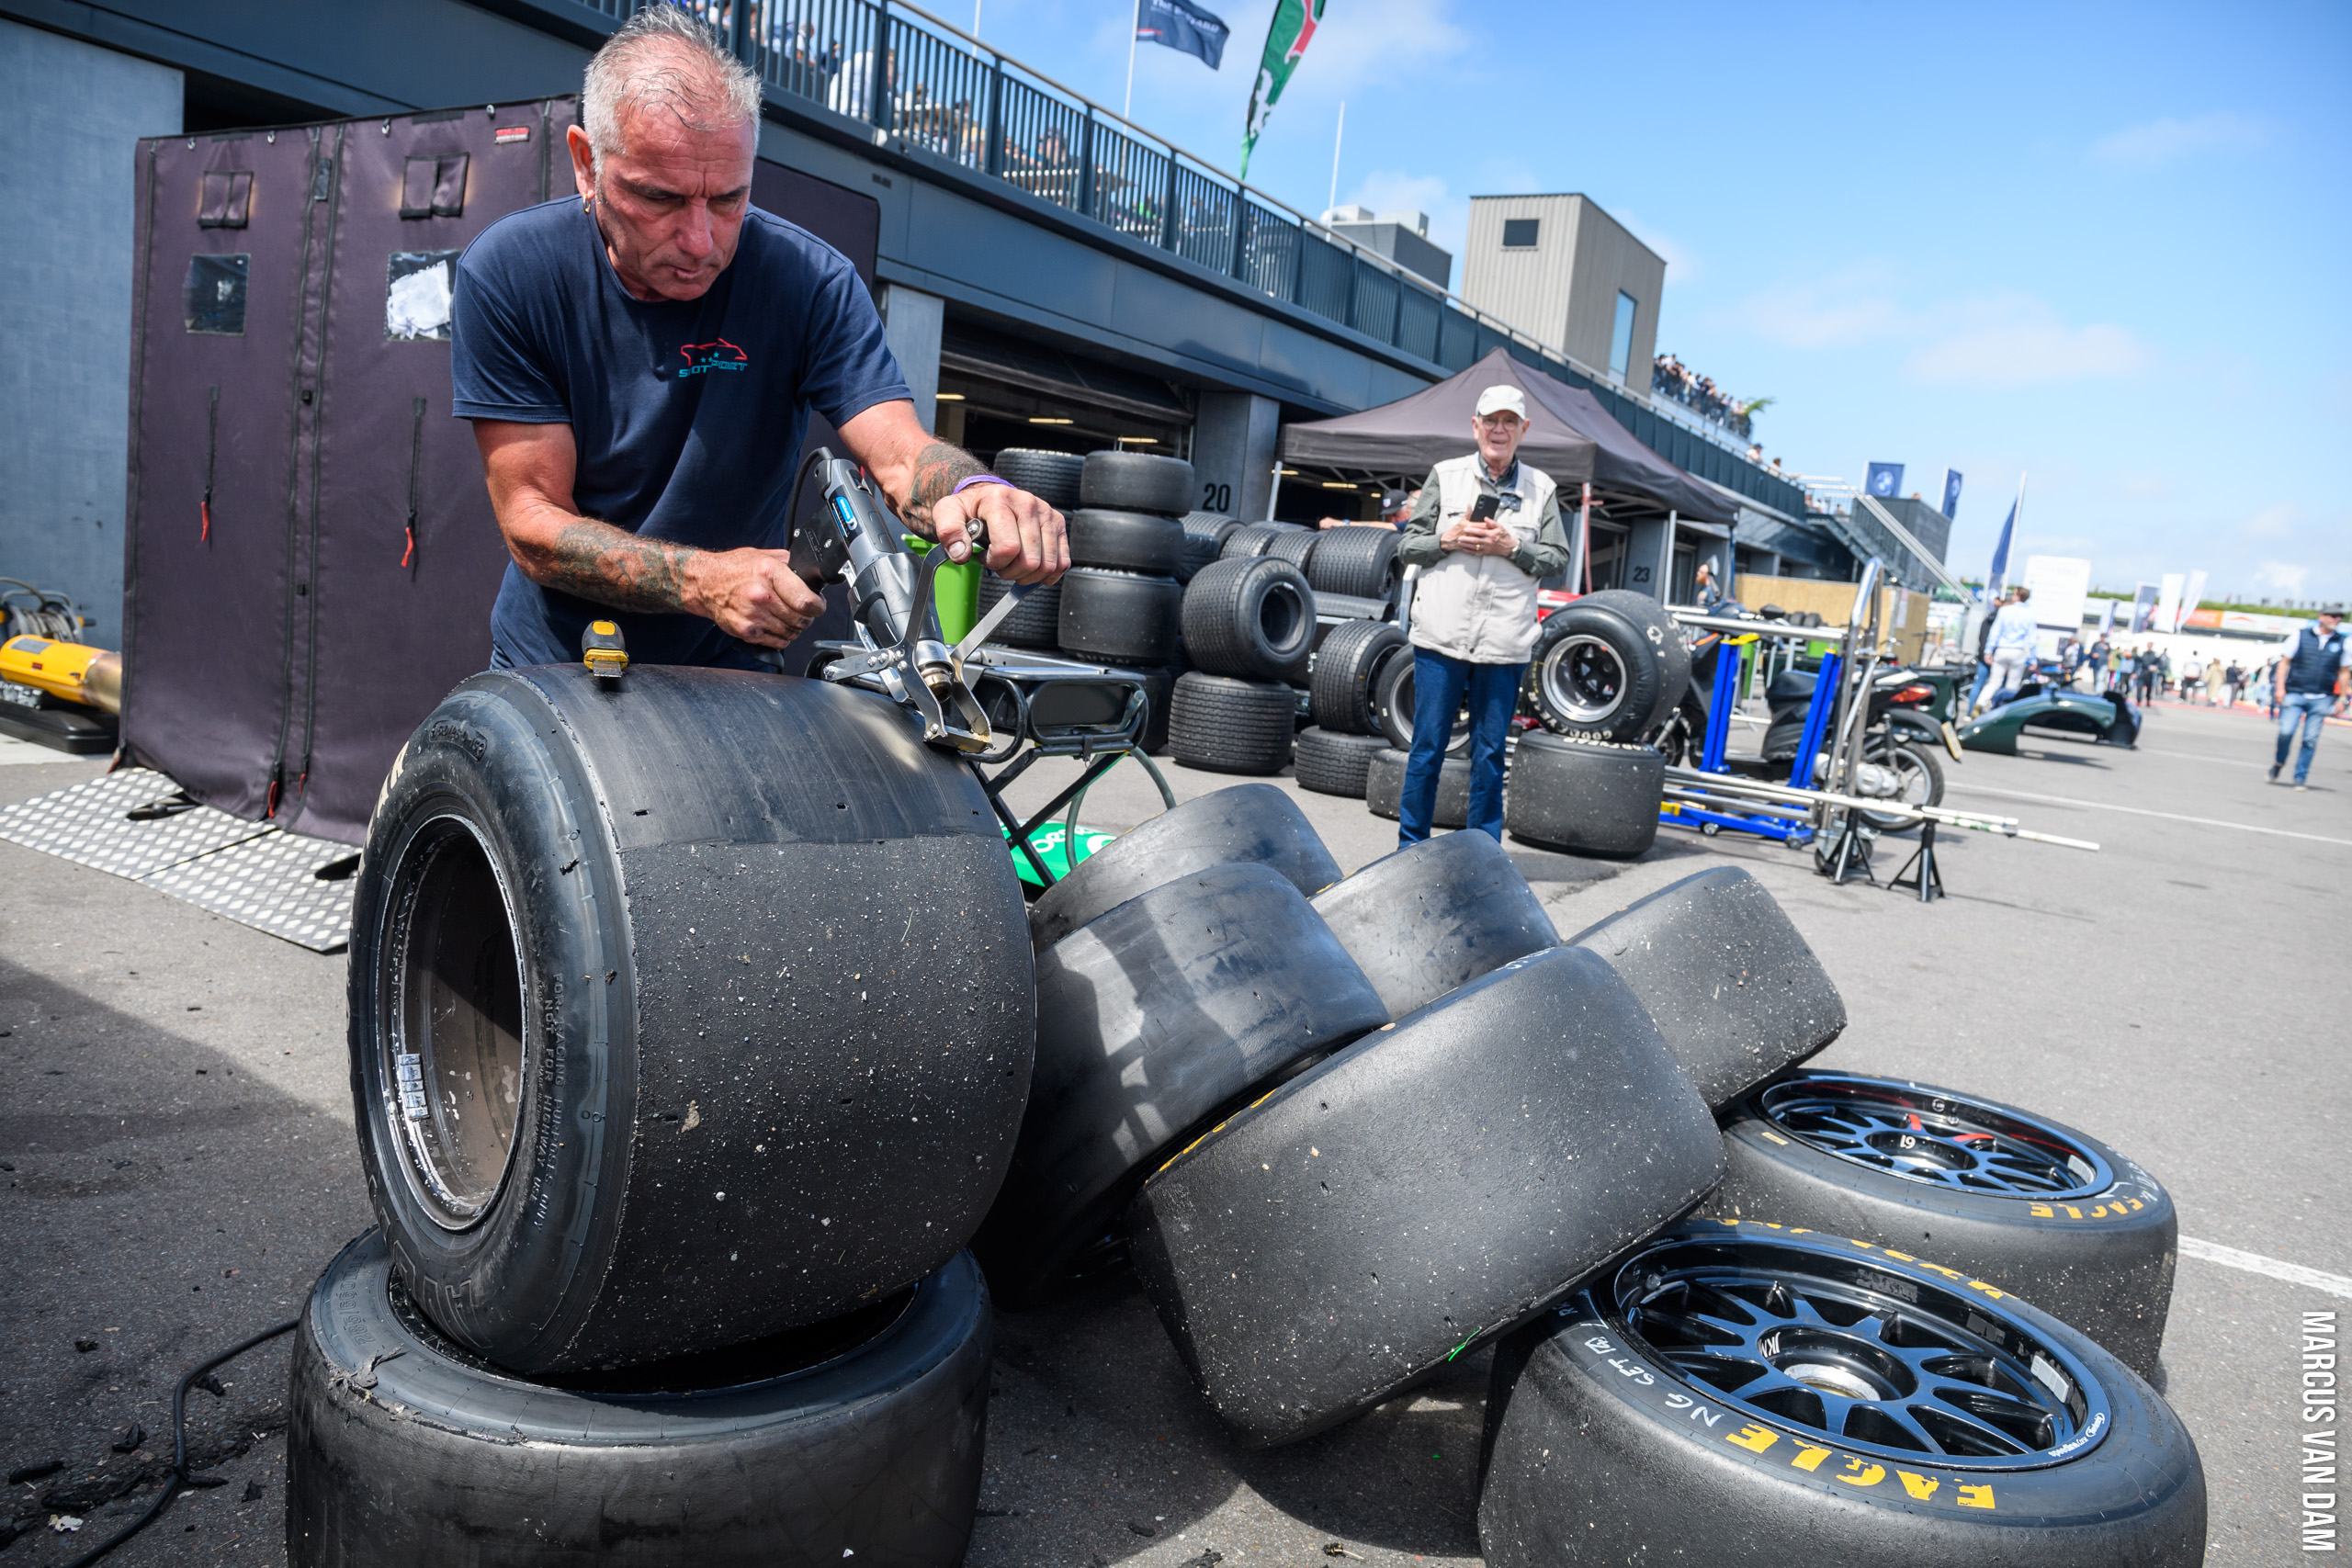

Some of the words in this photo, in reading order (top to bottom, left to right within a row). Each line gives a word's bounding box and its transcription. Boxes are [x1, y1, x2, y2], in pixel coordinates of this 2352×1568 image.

[1201, 482, 1231, 513] 20
[1633, 565, 1651, 583] 23
[553, 973, 565, 1008] FOR
[544, 999, 555, 1035] NOT
[544, 1048, 555, 1082] FOR
[555, 1020, 567, 1088] RACING
[537, 1094, 553, 1168] HIGHWAY
[544, 1098, 563, 1187] PURPOSES
[1899, 1134, 1917, 1150] 61
[529, 1176, 542, 1205] USE
[534, 1193, 550, 1233] ONLY
[1607, 1358, 1655, 1386] SET
[1724, 1423, 1996, 1509] EAGLE
